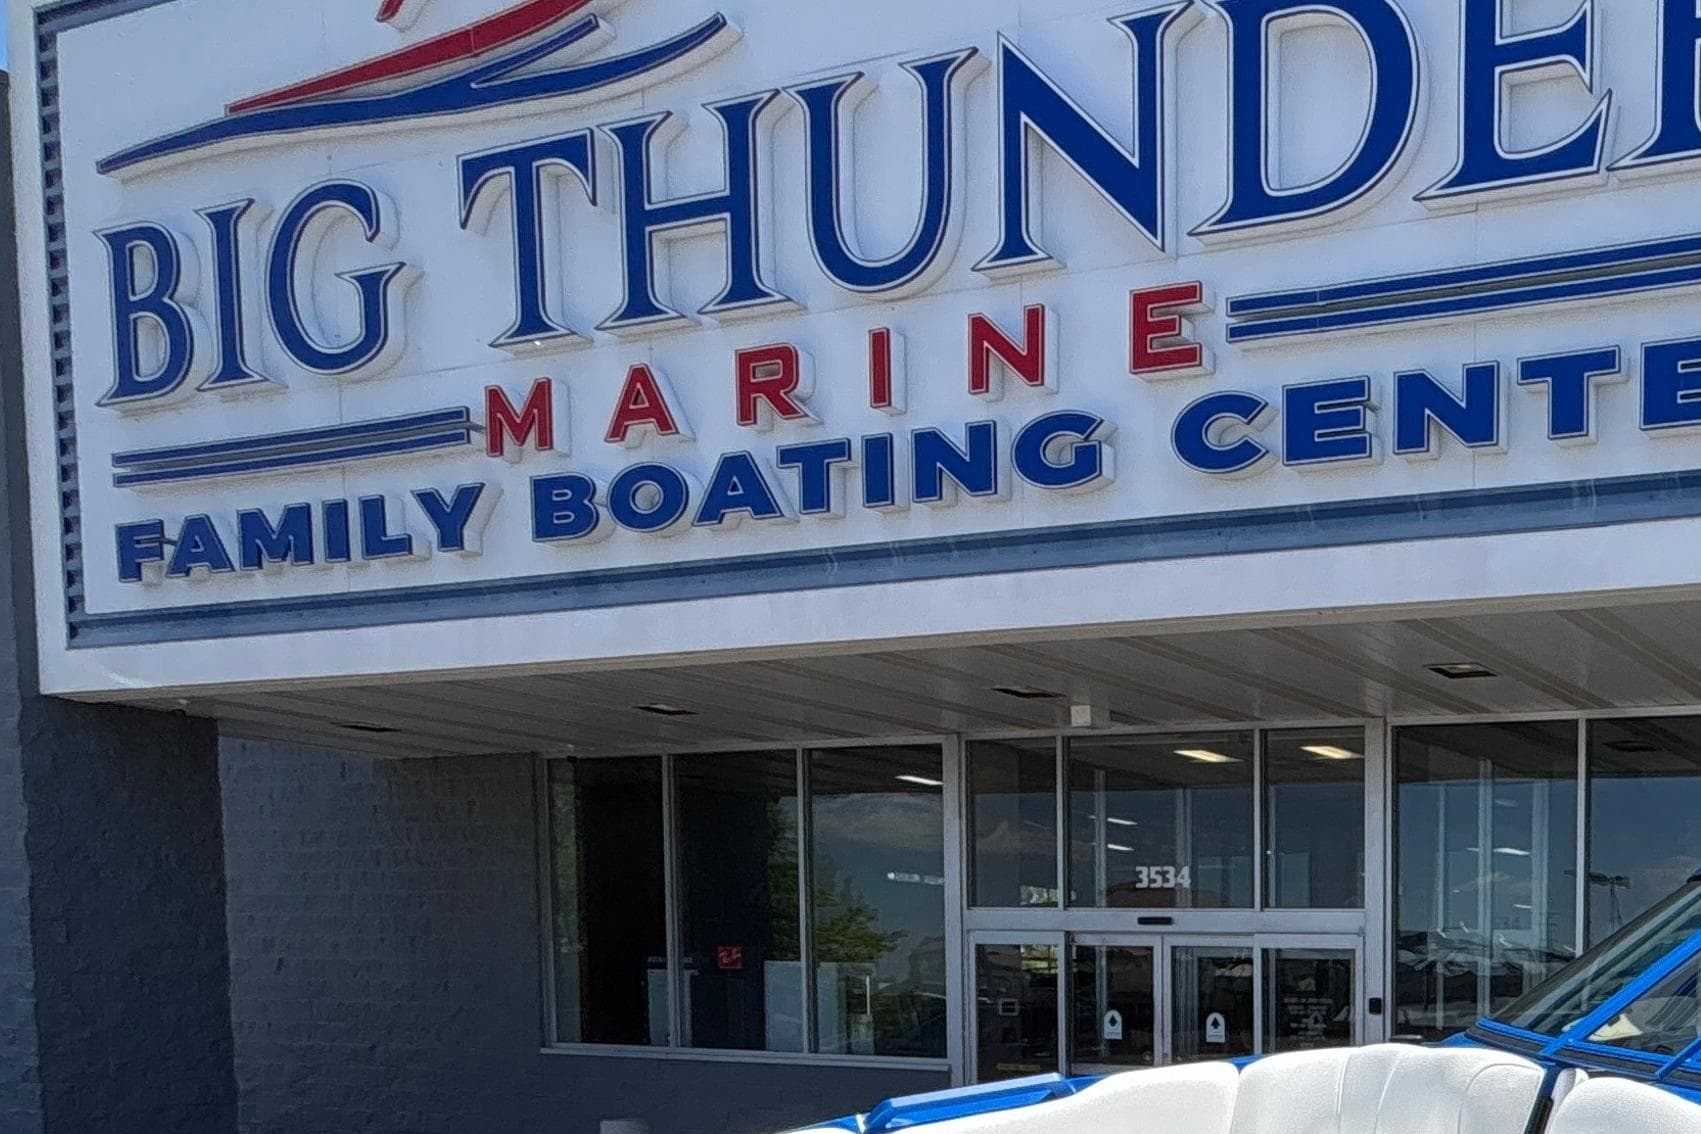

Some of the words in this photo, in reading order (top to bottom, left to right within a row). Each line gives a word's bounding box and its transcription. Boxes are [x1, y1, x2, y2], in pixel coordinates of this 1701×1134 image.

[93, 178, 410, 407] BIG
[484, 281, 1204, 457] MARINE
[115, 482, 485, 582] FAMILY
[530, 411, 1104, 543] BOATING
[1135, 866, 1191, 889] 3534
